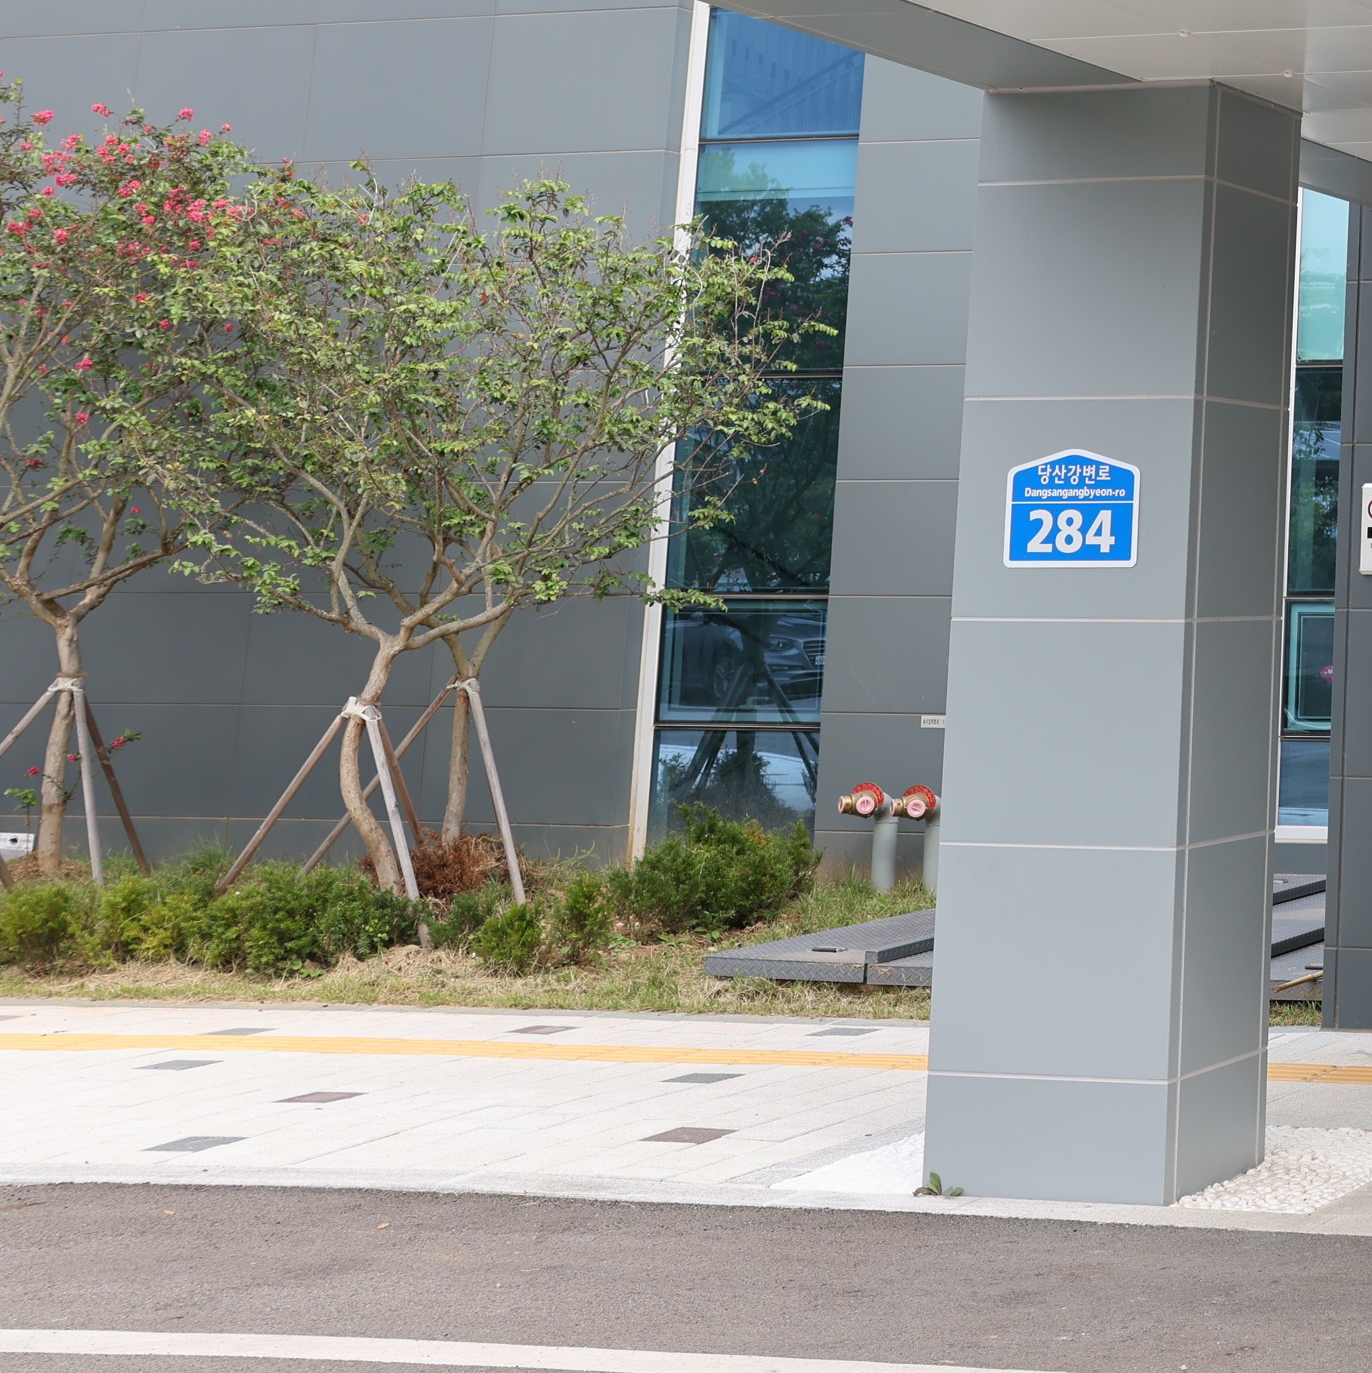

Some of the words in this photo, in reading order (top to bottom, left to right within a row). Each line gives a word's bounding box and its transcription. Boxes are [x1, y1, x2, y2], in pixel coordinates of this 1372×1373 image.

[1038, 464, 1111, 485] 당산강변로
[1024, 486, 1126, 499] Dangsangangbyeon-ro
[1026, 508, 1116, 554] 284
